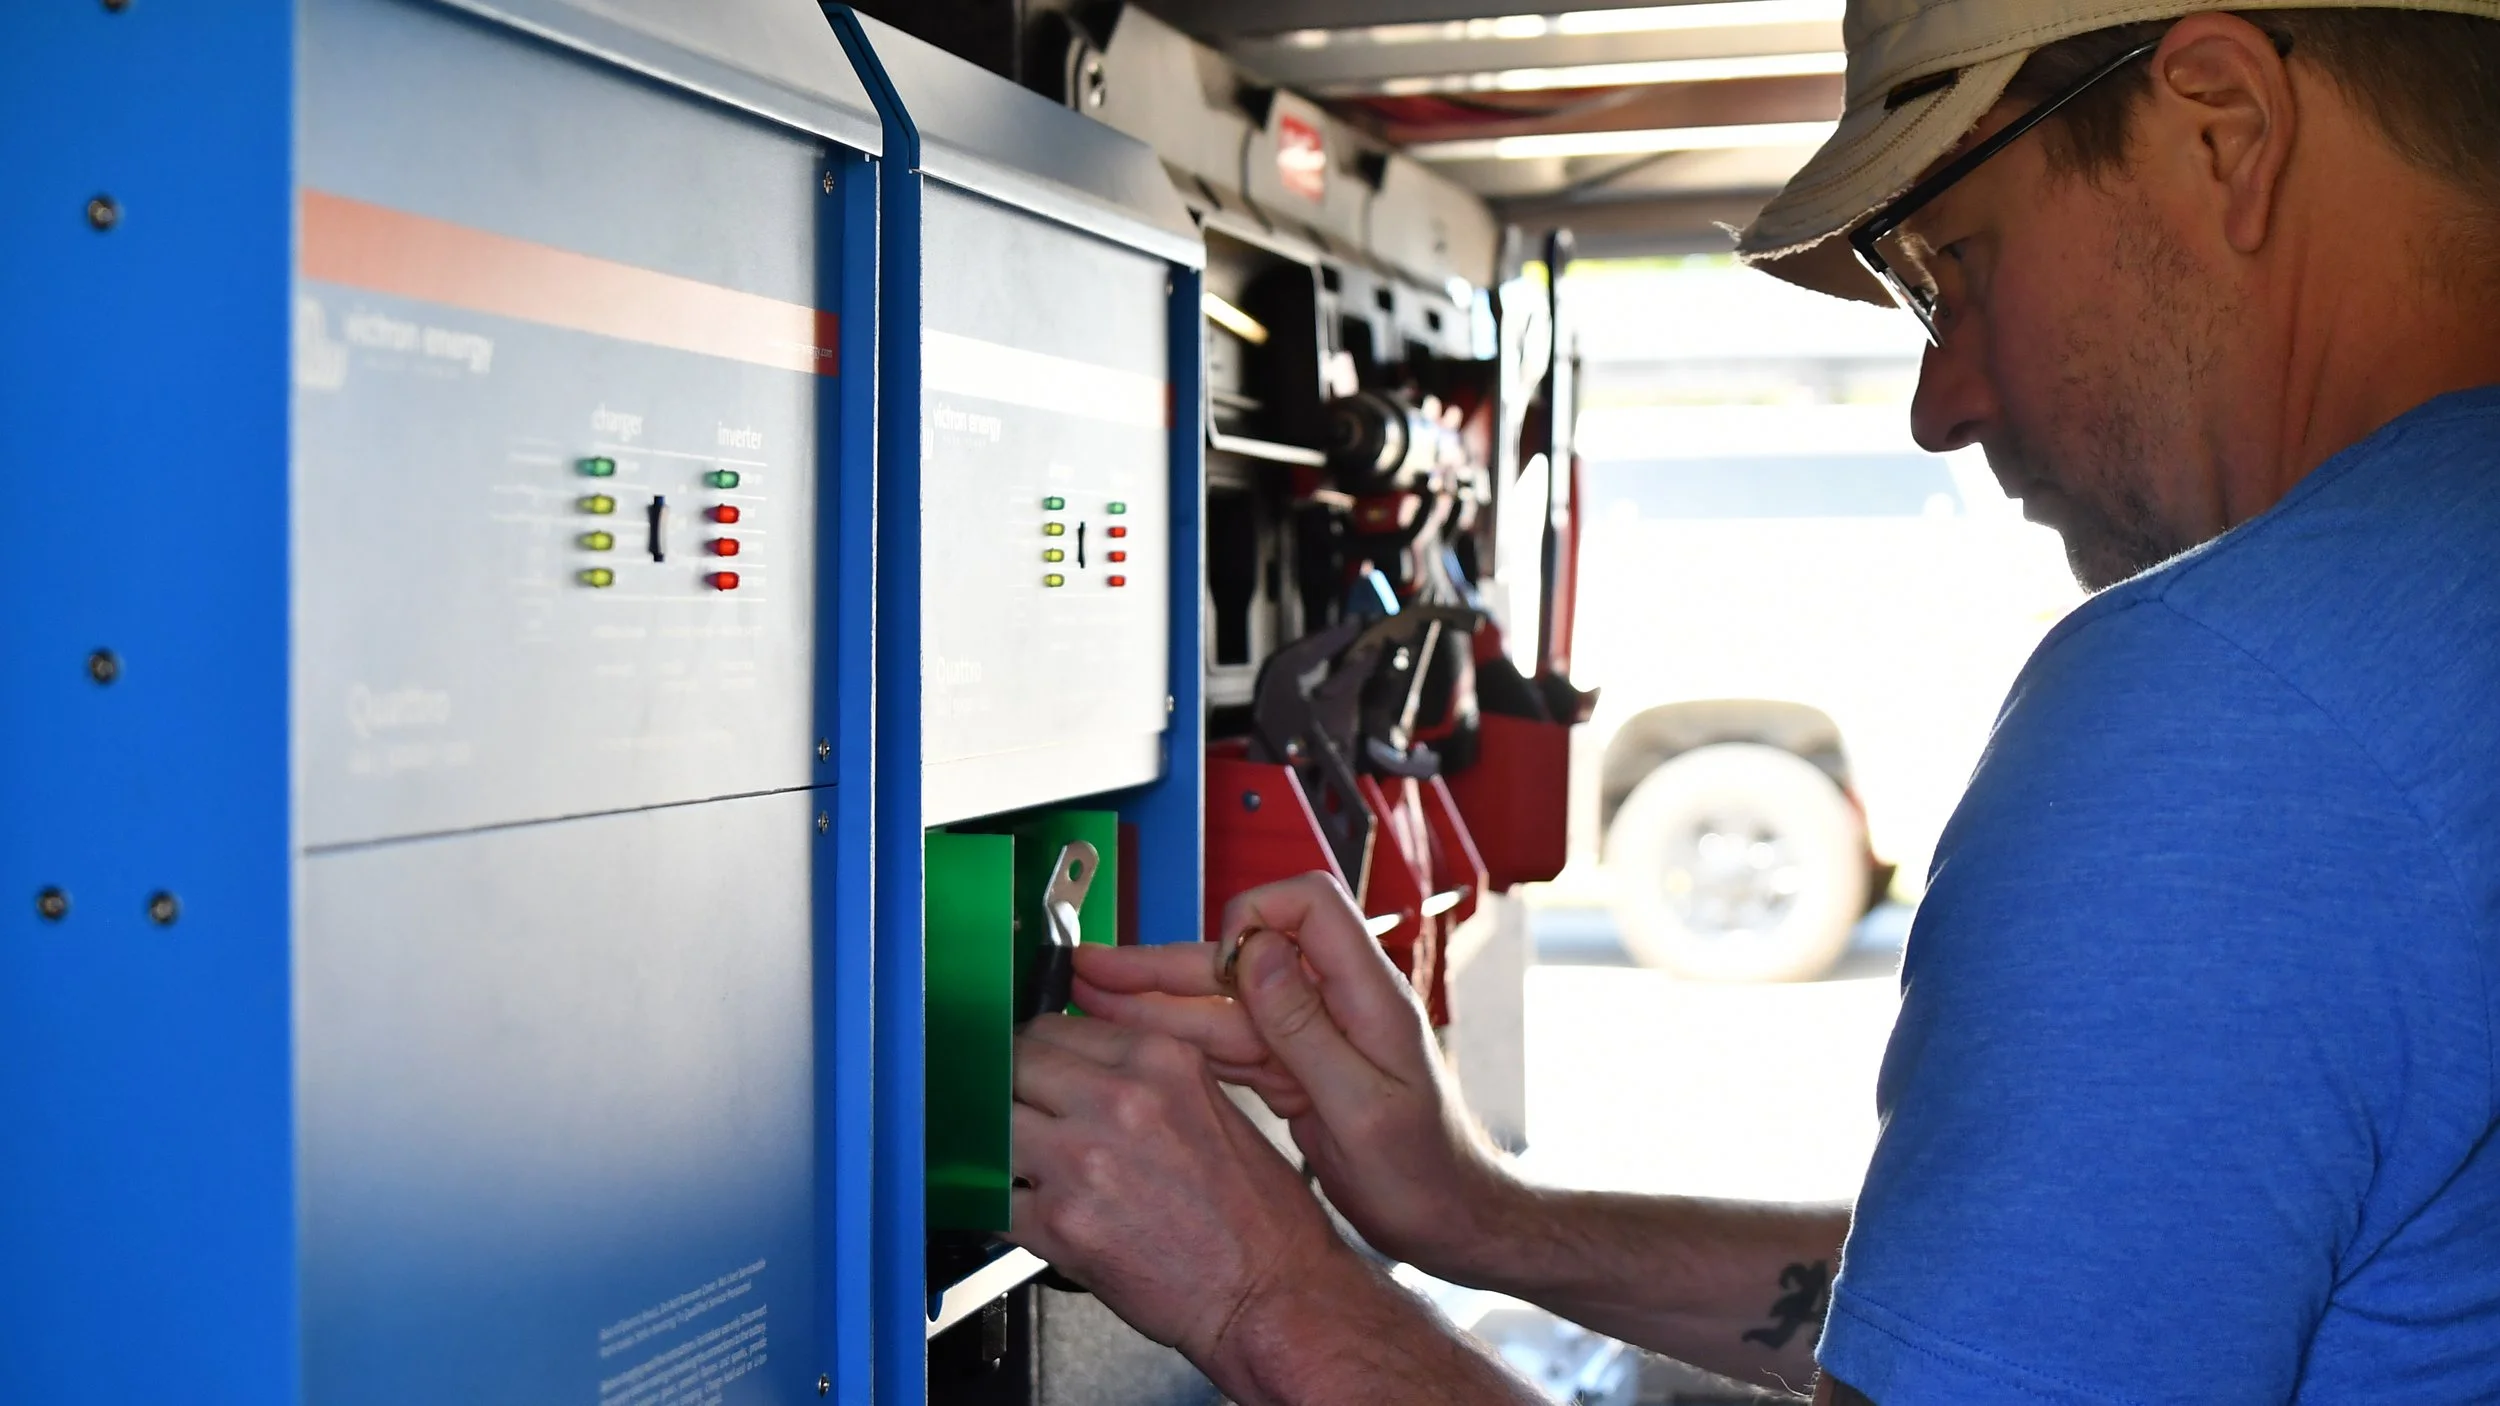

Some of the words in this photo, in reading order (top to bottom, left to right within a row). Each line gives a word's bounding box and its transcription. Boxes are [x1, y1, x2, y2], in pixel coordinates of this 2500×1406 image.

[591, 402, 644, 442] charger
[717, 420, 763, 449] inverter
[932, 401, 967, 431] victron
[968, 413, 1001, 443] energy
[936, 654, 982, 694] Quattro
